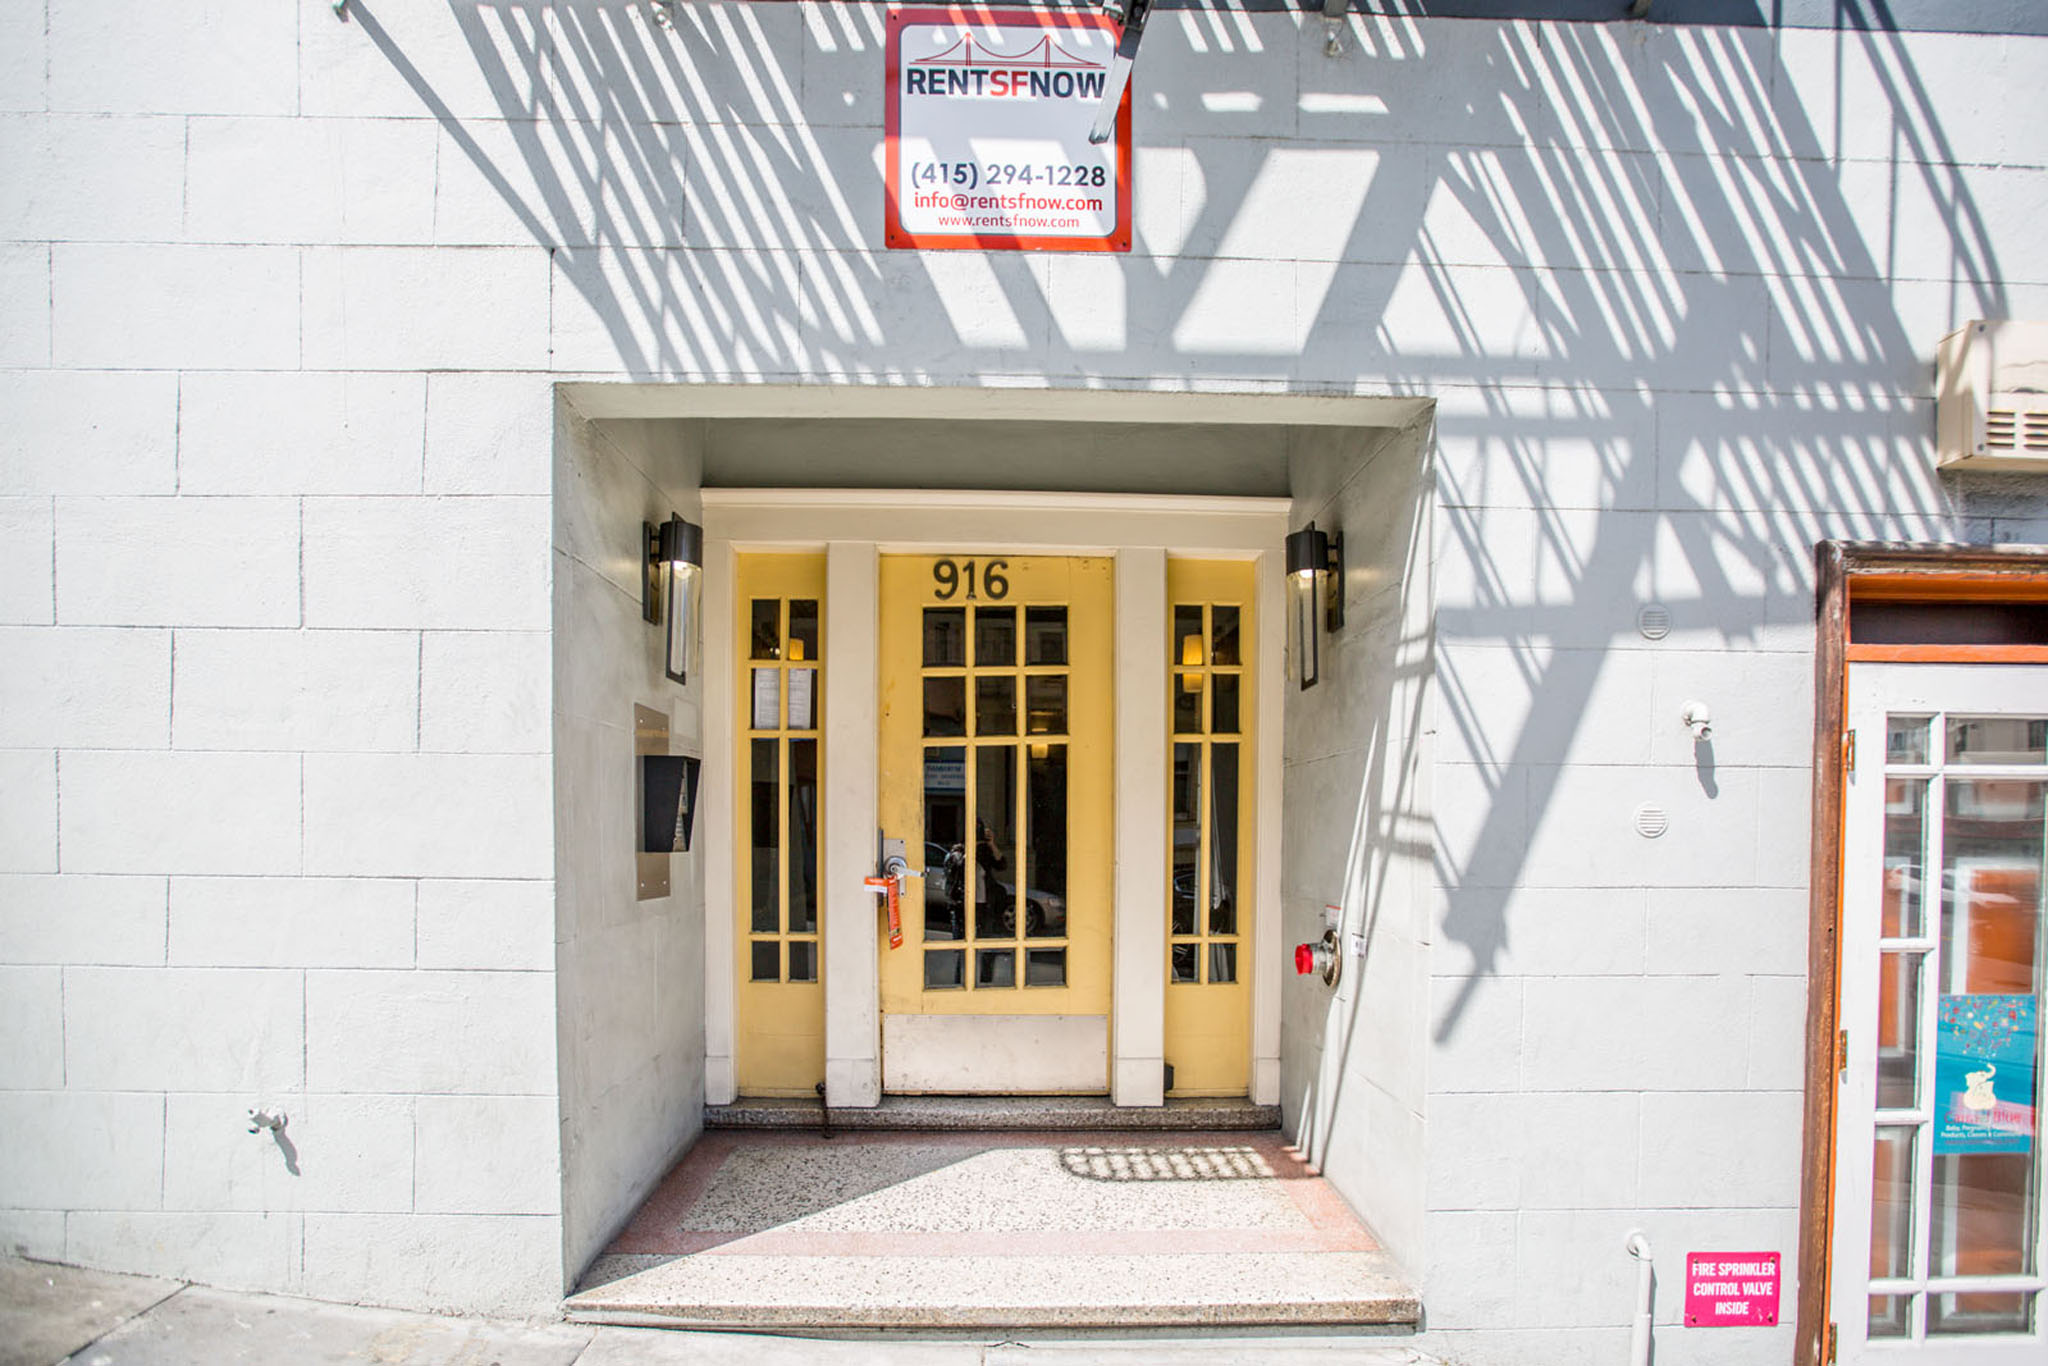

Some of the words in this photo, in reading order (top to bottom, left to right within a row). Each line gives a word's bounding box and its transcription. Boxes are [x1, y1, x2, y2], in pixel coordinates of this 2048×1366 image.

[907, 69, 1106, 98] RENTSFNOW
[911, 162, 979, 190] (415)
[986, 164, 1106, 187] 294-1228
[914, 192, 1103, 212] info@rentsfnow.com
[938, 214, 1080, 229] www.rentsfnow.com
[932, 559, 1009, 600] 916
[1692, 1262, 1716, 1276] FIRE
[1718, 1262, 1775, 1276] SPRINKLER
[1693, 1282, 1740, 1296] CONTROL
[1742, 1282, 1773, 1296] VALVE
[1715, 1301, 1749, 1315] INSIDE
